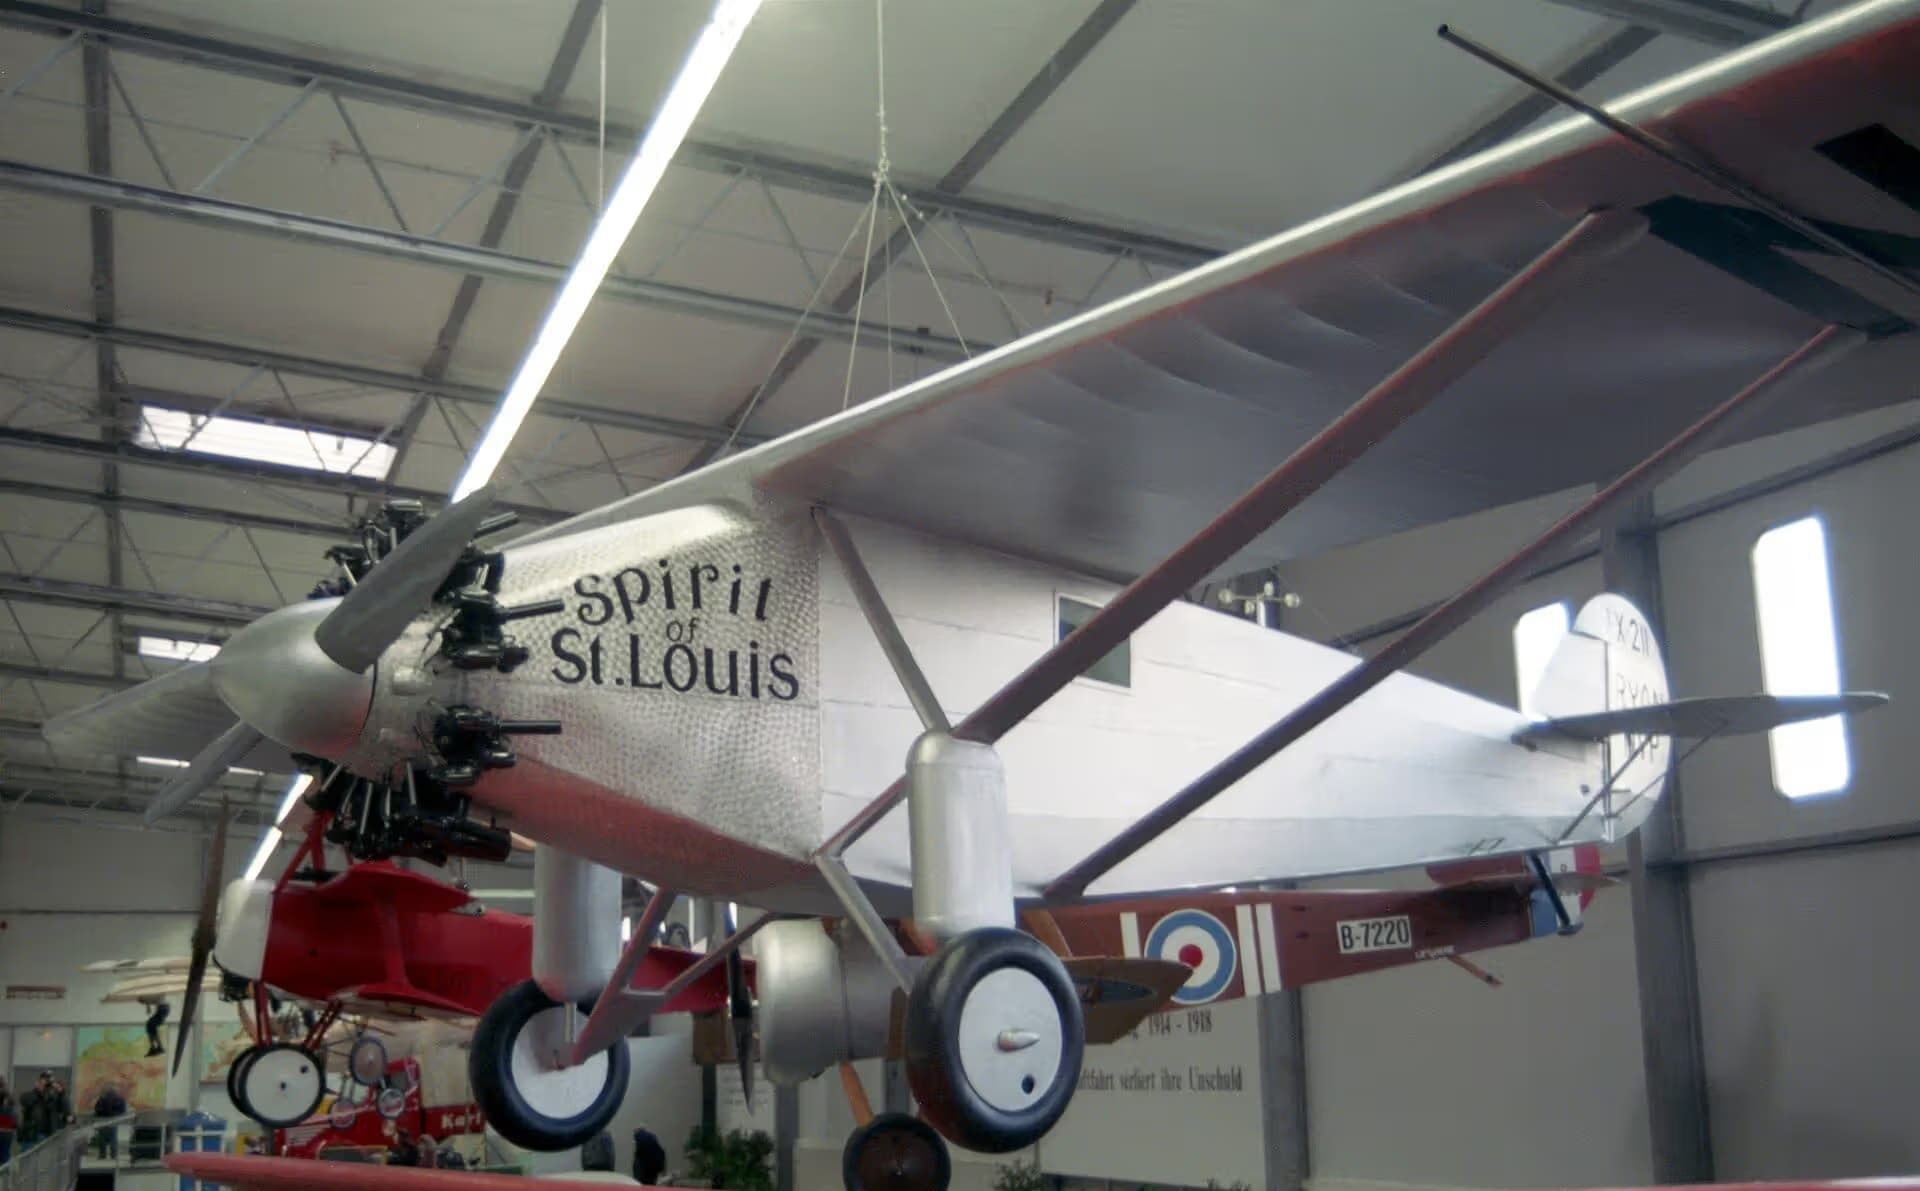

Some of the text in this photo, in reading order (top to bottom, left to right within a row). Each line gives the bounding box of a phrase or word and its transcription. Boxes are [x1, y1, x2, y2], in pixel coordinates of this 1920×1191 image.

[574, 559, 771, 625] Spirit
[1341, 920, 1409, 949] B-7220
[1187, 1010, 1212, 1033] 1918
[1189, 1064, 1242, 1091] Unschuld
